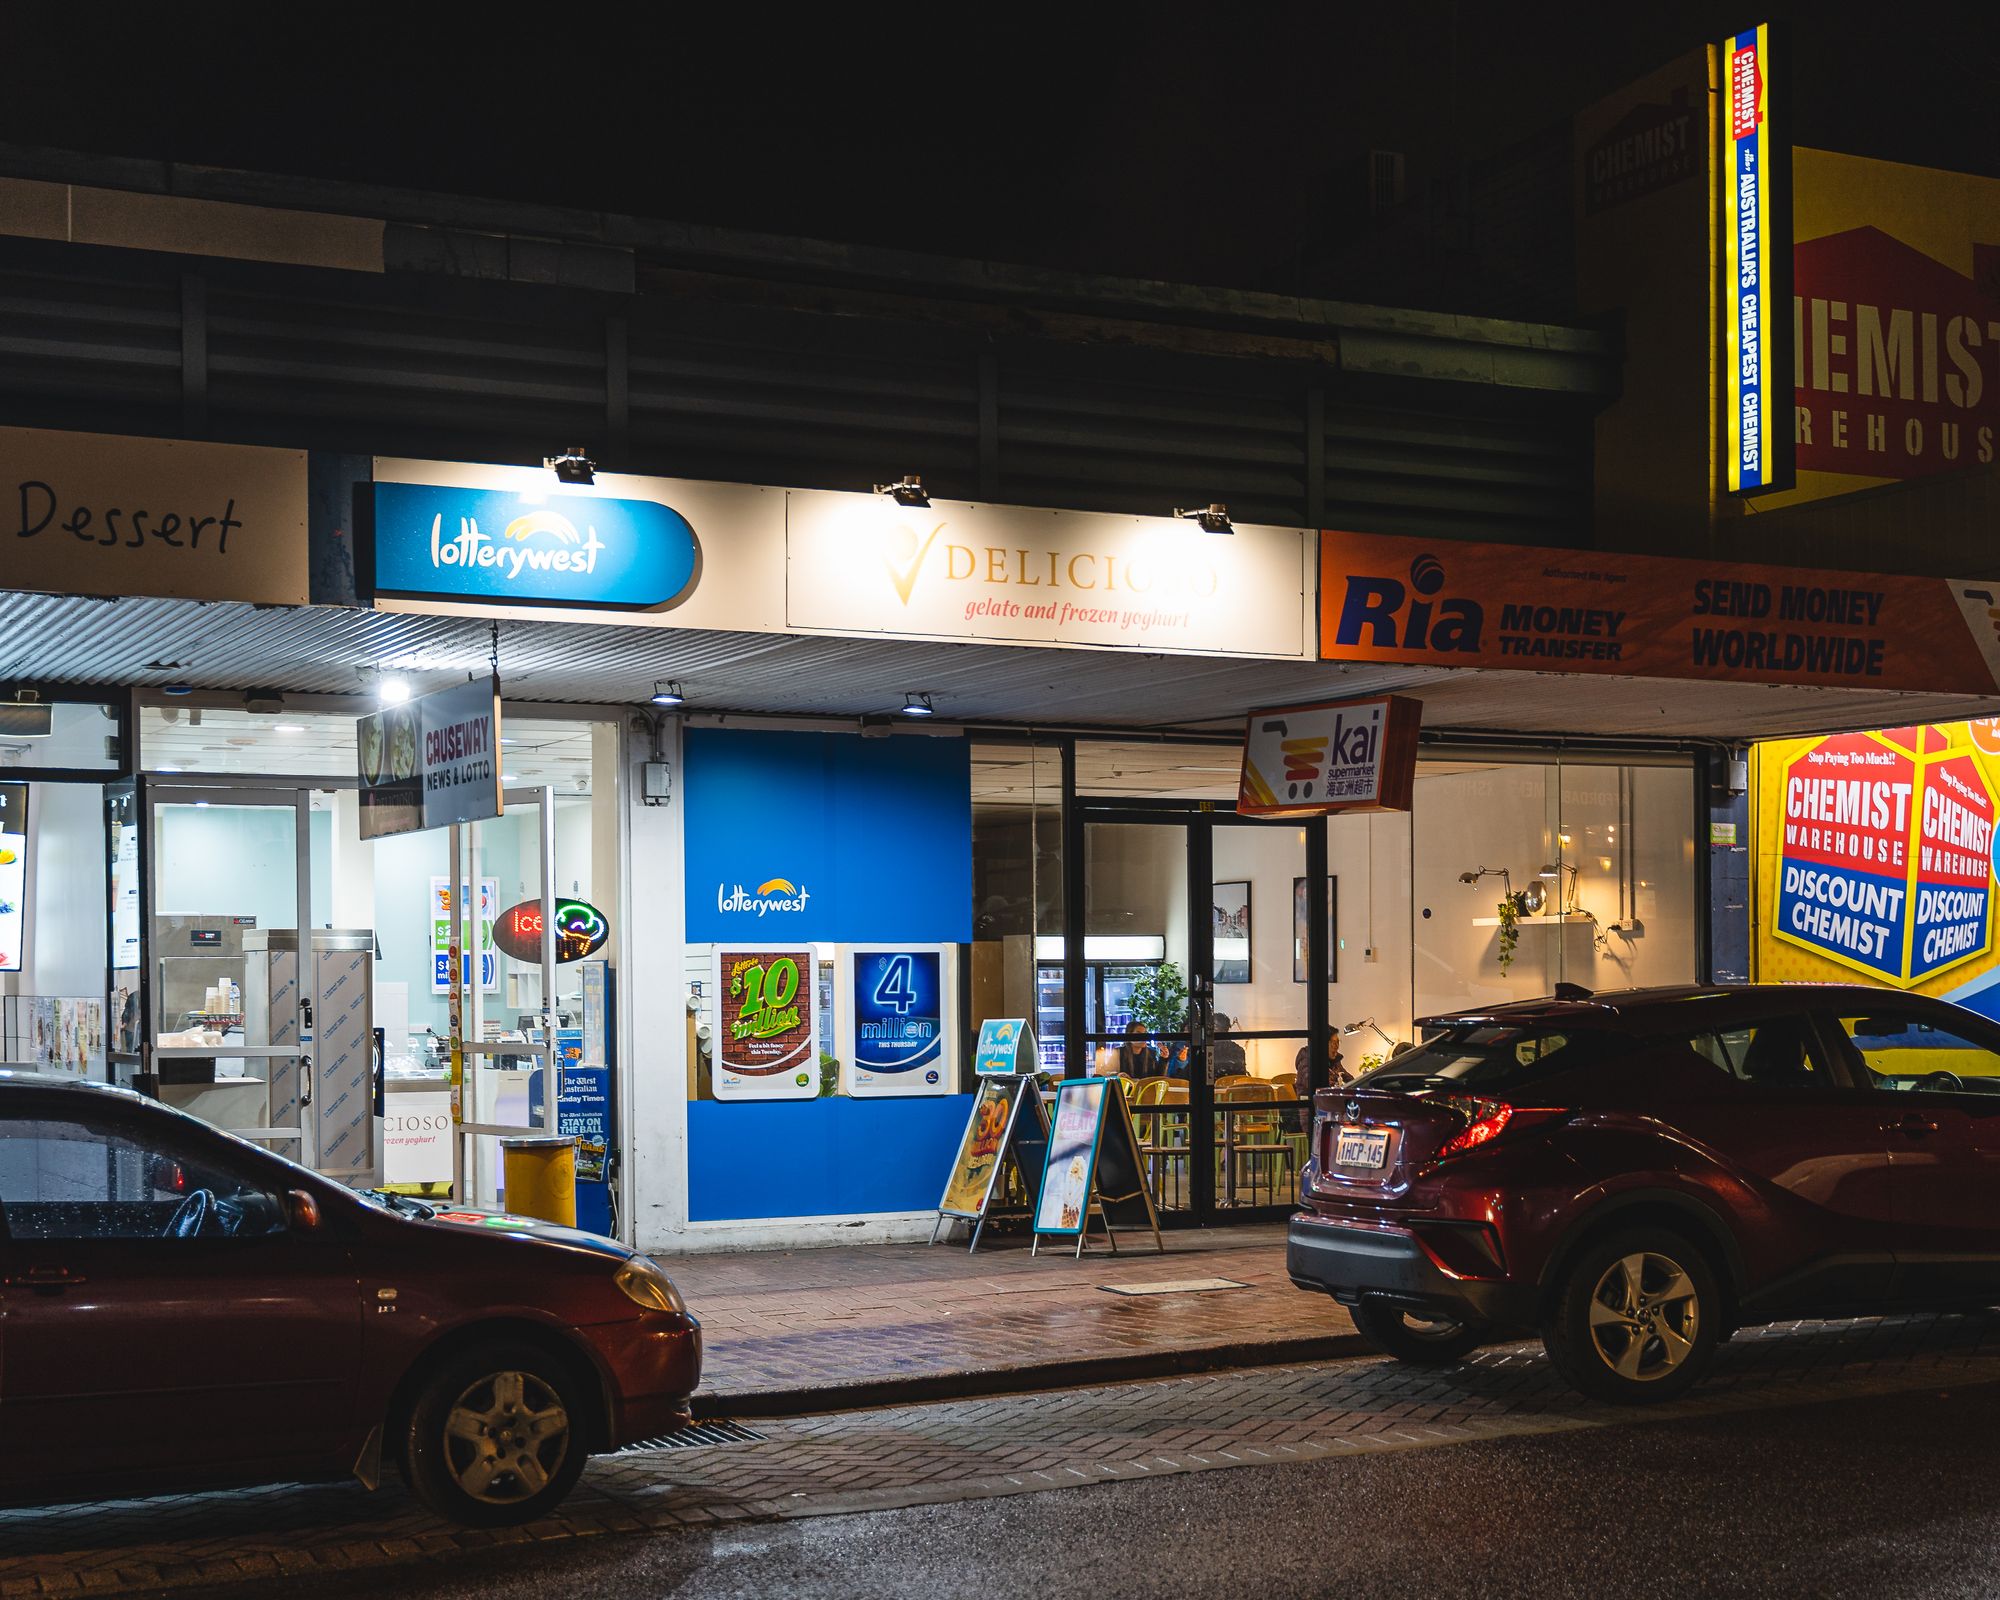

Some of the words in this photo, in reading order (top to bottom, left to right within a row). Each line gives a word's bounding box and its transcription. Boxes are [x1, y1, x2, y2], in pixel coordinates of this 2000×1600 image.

[1733, 56, 1742, 135] WAREHOUSE
[1741, 51, 1755, 129] CHEMIST
[1592, 116, 1690, 184] CHEMIST
[1740, 174, 1757, 289] AUSTRALIA'S
[1740, 294, 1758, 386] CHEAPEST
[1741, 391, 1759, 471] CHEMIST
[17, 481, 242, 554] Dessert
[431, 511, 606, 580] lotterywest
[965, 597, 1021, 621] gelato
[1024, 601, 1056, 621] and
[1058, 601, 1119, 626] frozen
[1120, 608, 1191, 631] yoghurt
[1335, 553, 1483, 654] Ria
[1500, 602, 1626, 637] MONEY
[1692, 578, 1770, 616] SEND
[1778, 583, 1885, 627] MONEY
[1499, 635, 1622, 662] TRANSFER
[1692, 627, 1885, 677] WORLDWIDE
[426, 716, 490, 767] CAUSEWAY
[1331, 709, 1380, 766] kai
[1808, 751, 1825, 766] Stop
[1825, 752, 1849, 767] Paying
[1850, 752, 1865, 765] Too
[1865, 753, 1896, 766] Much!!
[427, 767, 451, 792] NEWS
[453, 771, 460, 786] &
[462, 759, 490, 785] LOTTO
[1327, 764, 1376, 781] supermarket
[1787, 777, 1912, 832] CHEMIST
[1922, 785, 1992, 856] CHEMIST
[1786, 823, 1903, 866] WAREHOUSE
[1921, 845, 1988, 878] WAREHOUSE
[717, 882, 810, 918] lotterywest
[1785, 866, 1904, 923] DISCOUNT
[1916, 890, 1985, 925] DISCOUNT
[1791, 902, 1890, 960] CHEMIST
[1922, 922, 1979, 964] CHEMIST
[874, 955, 916, 1013] $4
[730, 1006, 801, 1040] million
[862, 1018, 932, 1039] million
[979, 1030, 1017, 1060] lotterywest
[576, 1077, 596, 1086] West
[582, 1094, 605, 1103] Times
[405, 1136, 437, 1146] yoghurt
[559, 1126, 579, 1134] THE
[580, 1125, 604, 1134] BALL
[561, 1118, 586, 1126] STAY
[586, 1118, 601, 1126] ON
